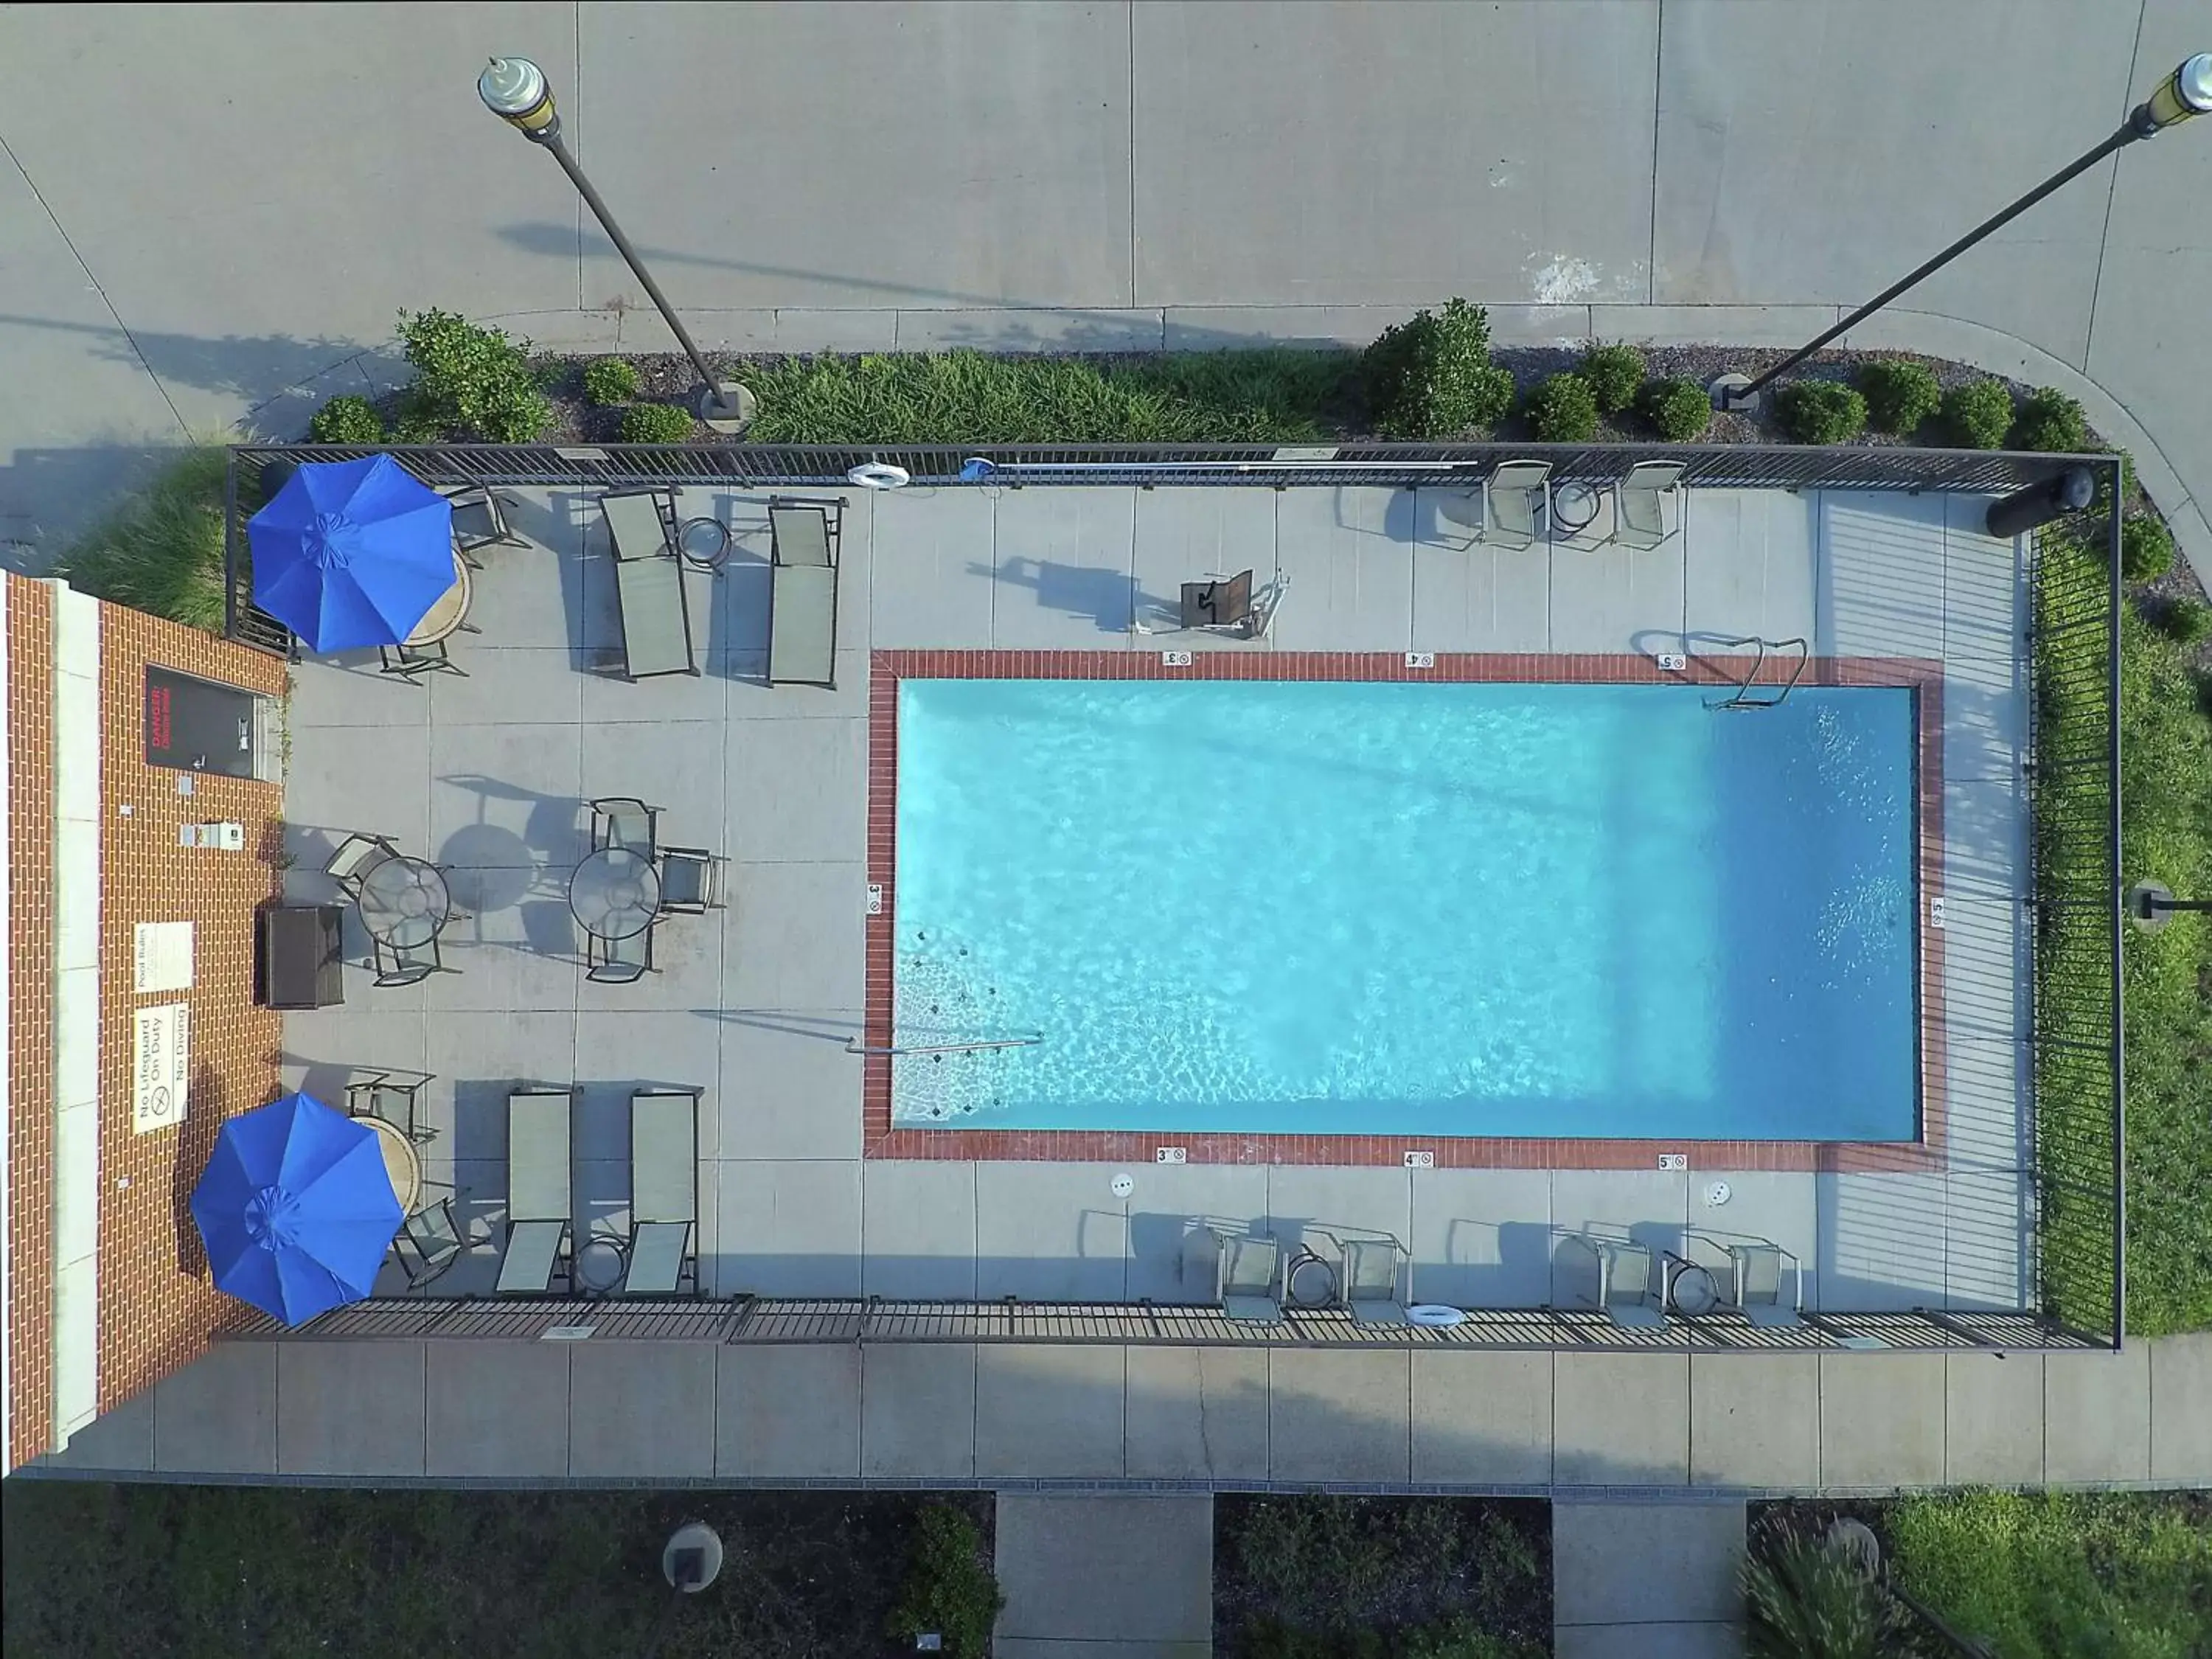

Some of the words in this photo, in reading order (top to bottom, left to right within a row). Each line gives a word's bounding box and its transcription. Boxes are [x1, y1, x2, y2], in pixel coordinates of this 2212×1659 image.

[1169, 653, 1176, 663] 3
[1663, 656, 1672, 667] 5
[138, 962, 147, 987] Pool
[151, 1018, 163, 1054] Duty
[176, 1009, 187, 1055] Diving
[139, 1020, 150, 1091] Lifeguard
[151, 1059, 160, 1081] On
[176, 1061, 184, 1081] No
[139, 1096, 150, 1118] No
[1158, 1150, 1166, 1161] 3
[1405, 1154, 1413, 1165] 4
[1660, 1157, 1667, 1168] 5
